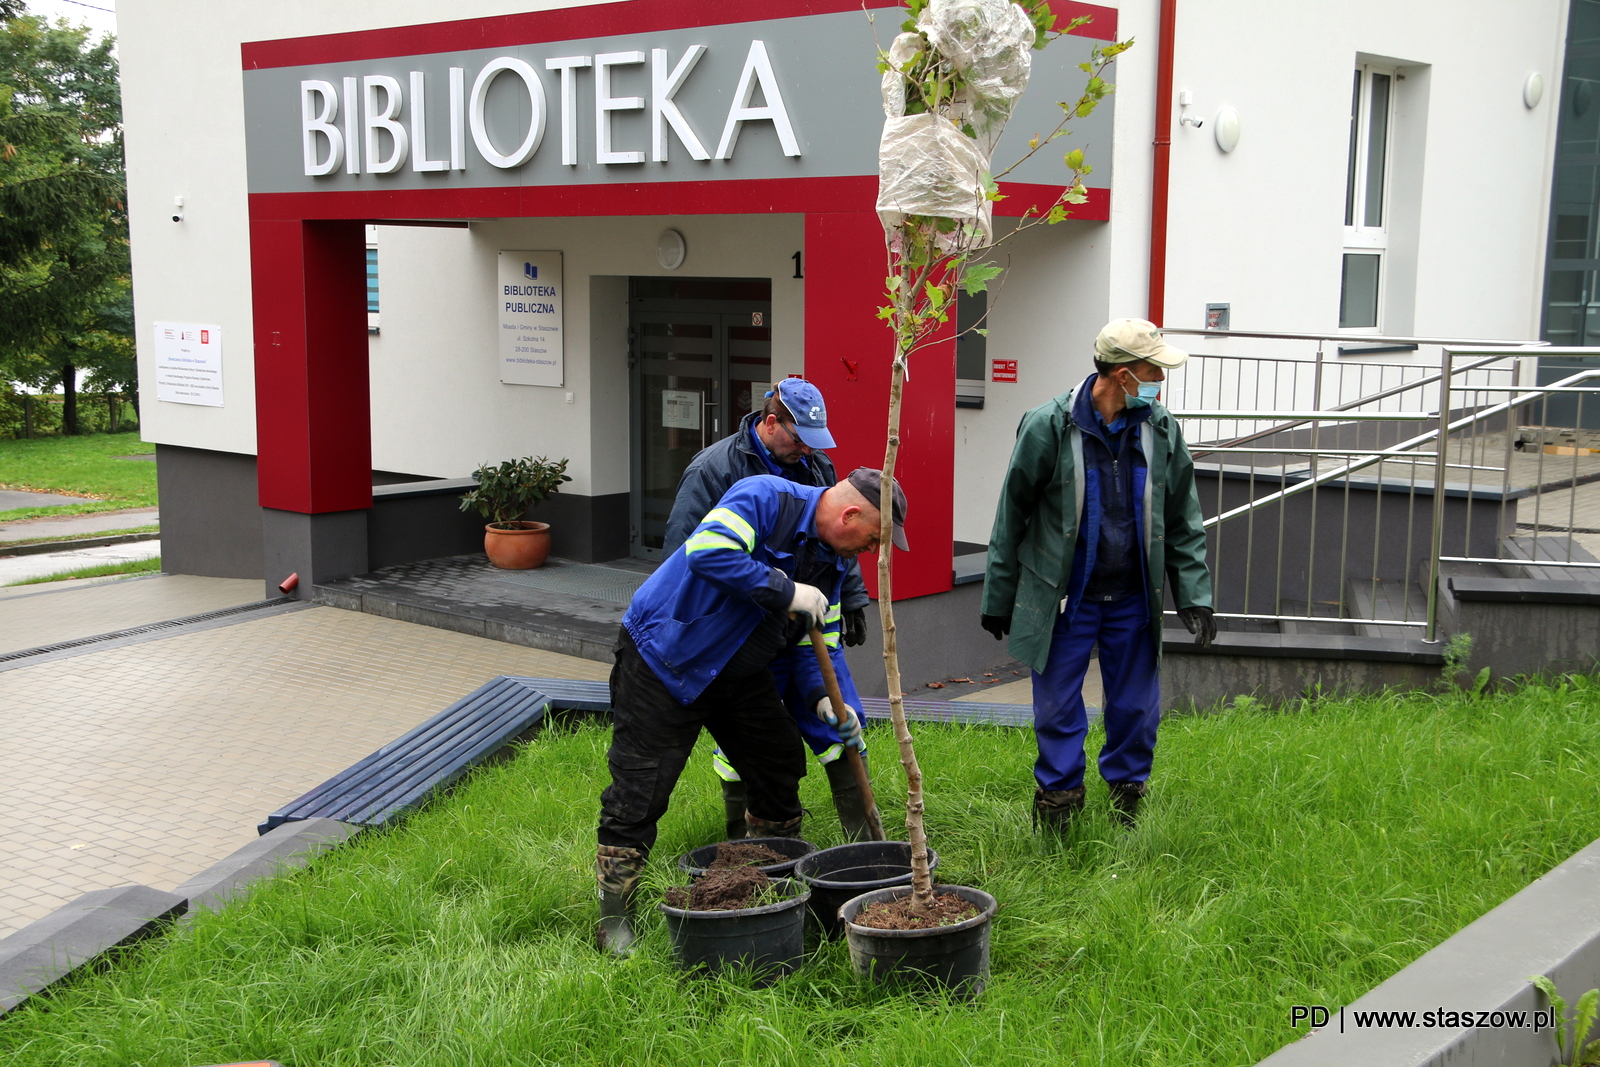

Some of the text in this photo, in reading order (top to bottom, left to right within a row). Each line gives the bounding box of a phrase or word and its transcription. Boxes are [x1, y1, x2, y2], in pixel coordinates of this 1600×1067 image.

[300, 39, 802, 177] BIBLIOTEKA
[791, 251, 804, 279] 1
[504, 285, 556, 297] BIBLIOTEKA
[505, 302, 555, 314] PUBLICZNA
[520, 324, 533, 332] Gminy
[506, 358, 556, 366] www.biblioteka-staszow.pl
